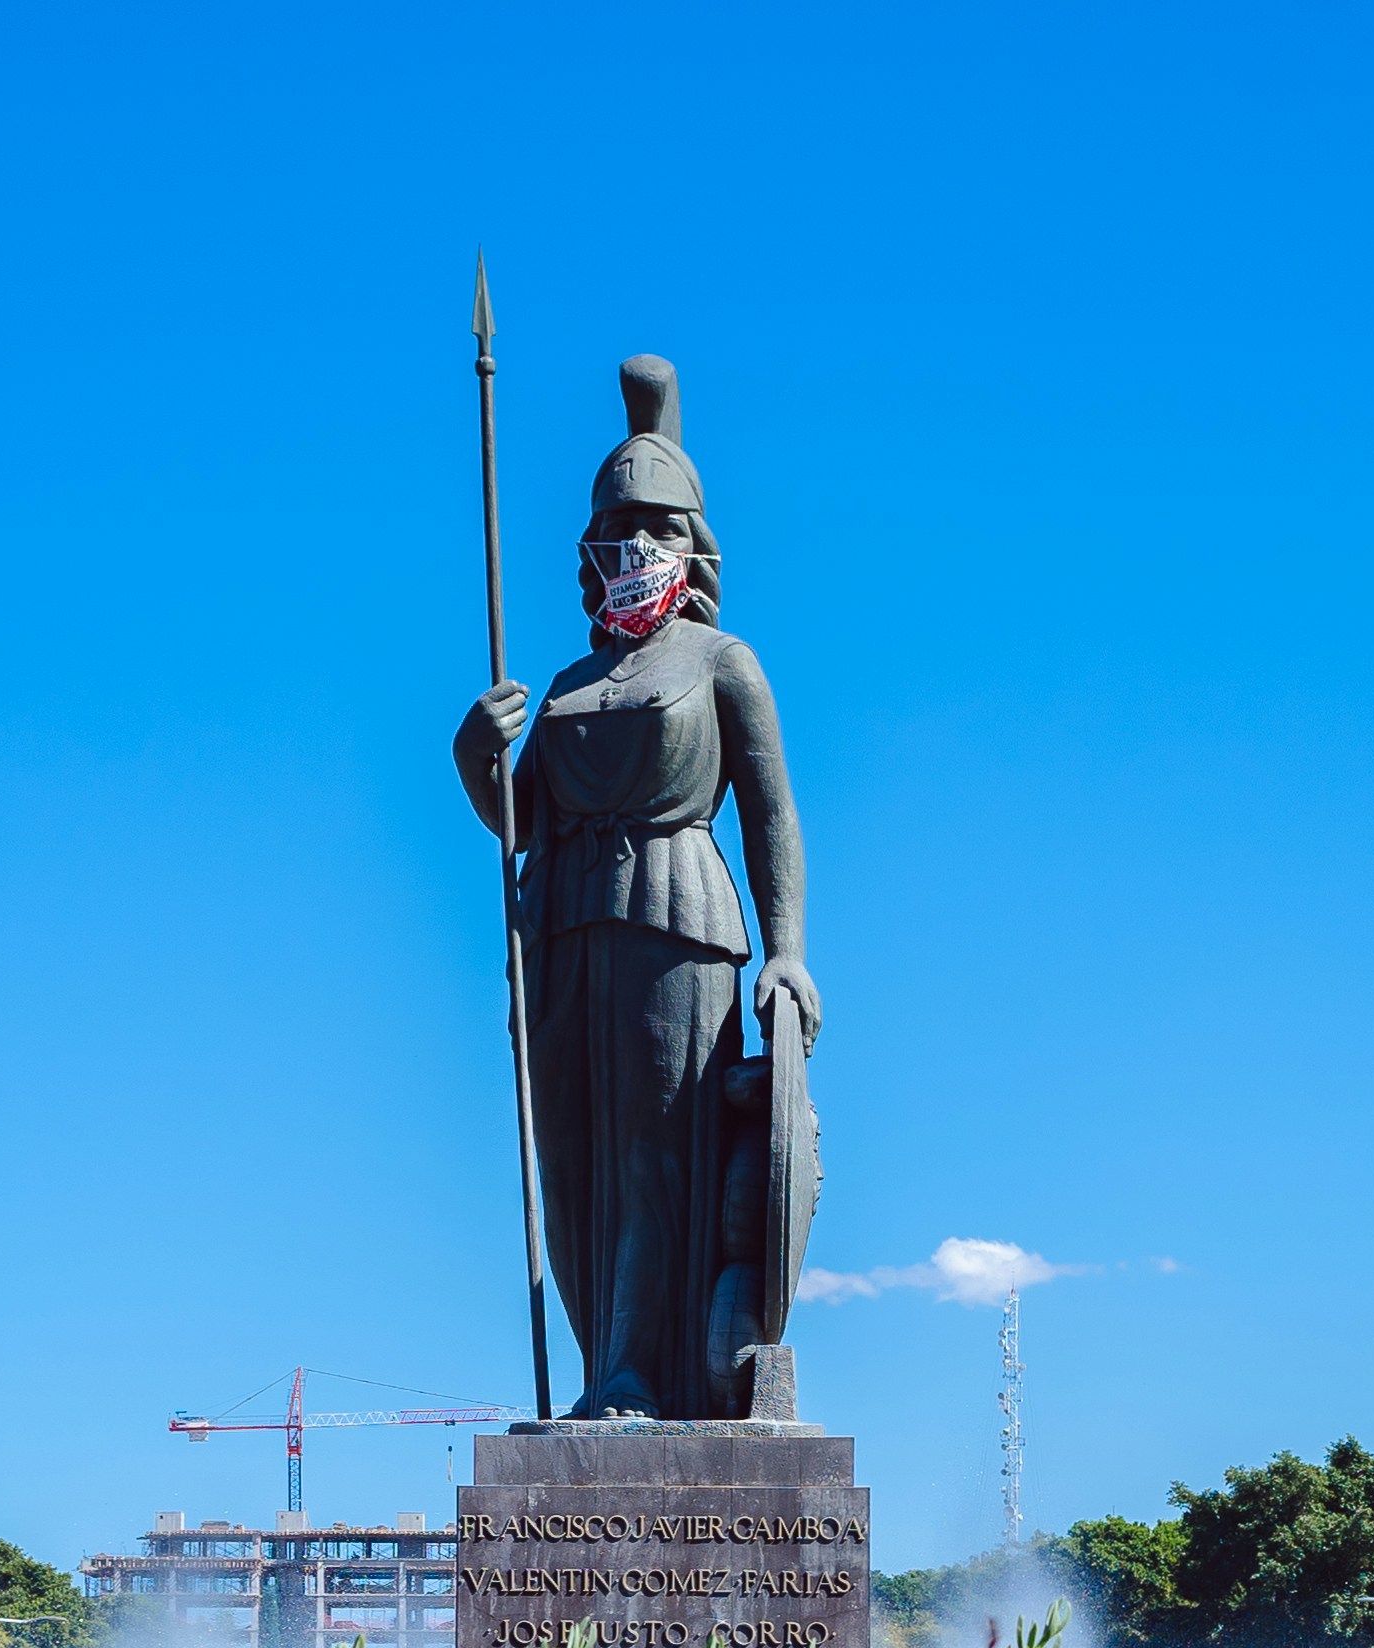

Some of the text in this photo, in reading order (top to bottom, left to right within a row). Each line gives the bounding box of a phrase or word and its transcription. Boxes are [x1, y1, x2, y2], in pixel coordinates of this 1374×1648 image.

[460, 1514, 865, 1543] FRANCISCO JAVIER GAMBOA
[463, 1568, 851, 1597] VALENTIN GOMEZ FARIAS
[590, 1620, 689, 1648] USTO
[712, 1622, 829, 1648] CORRO
